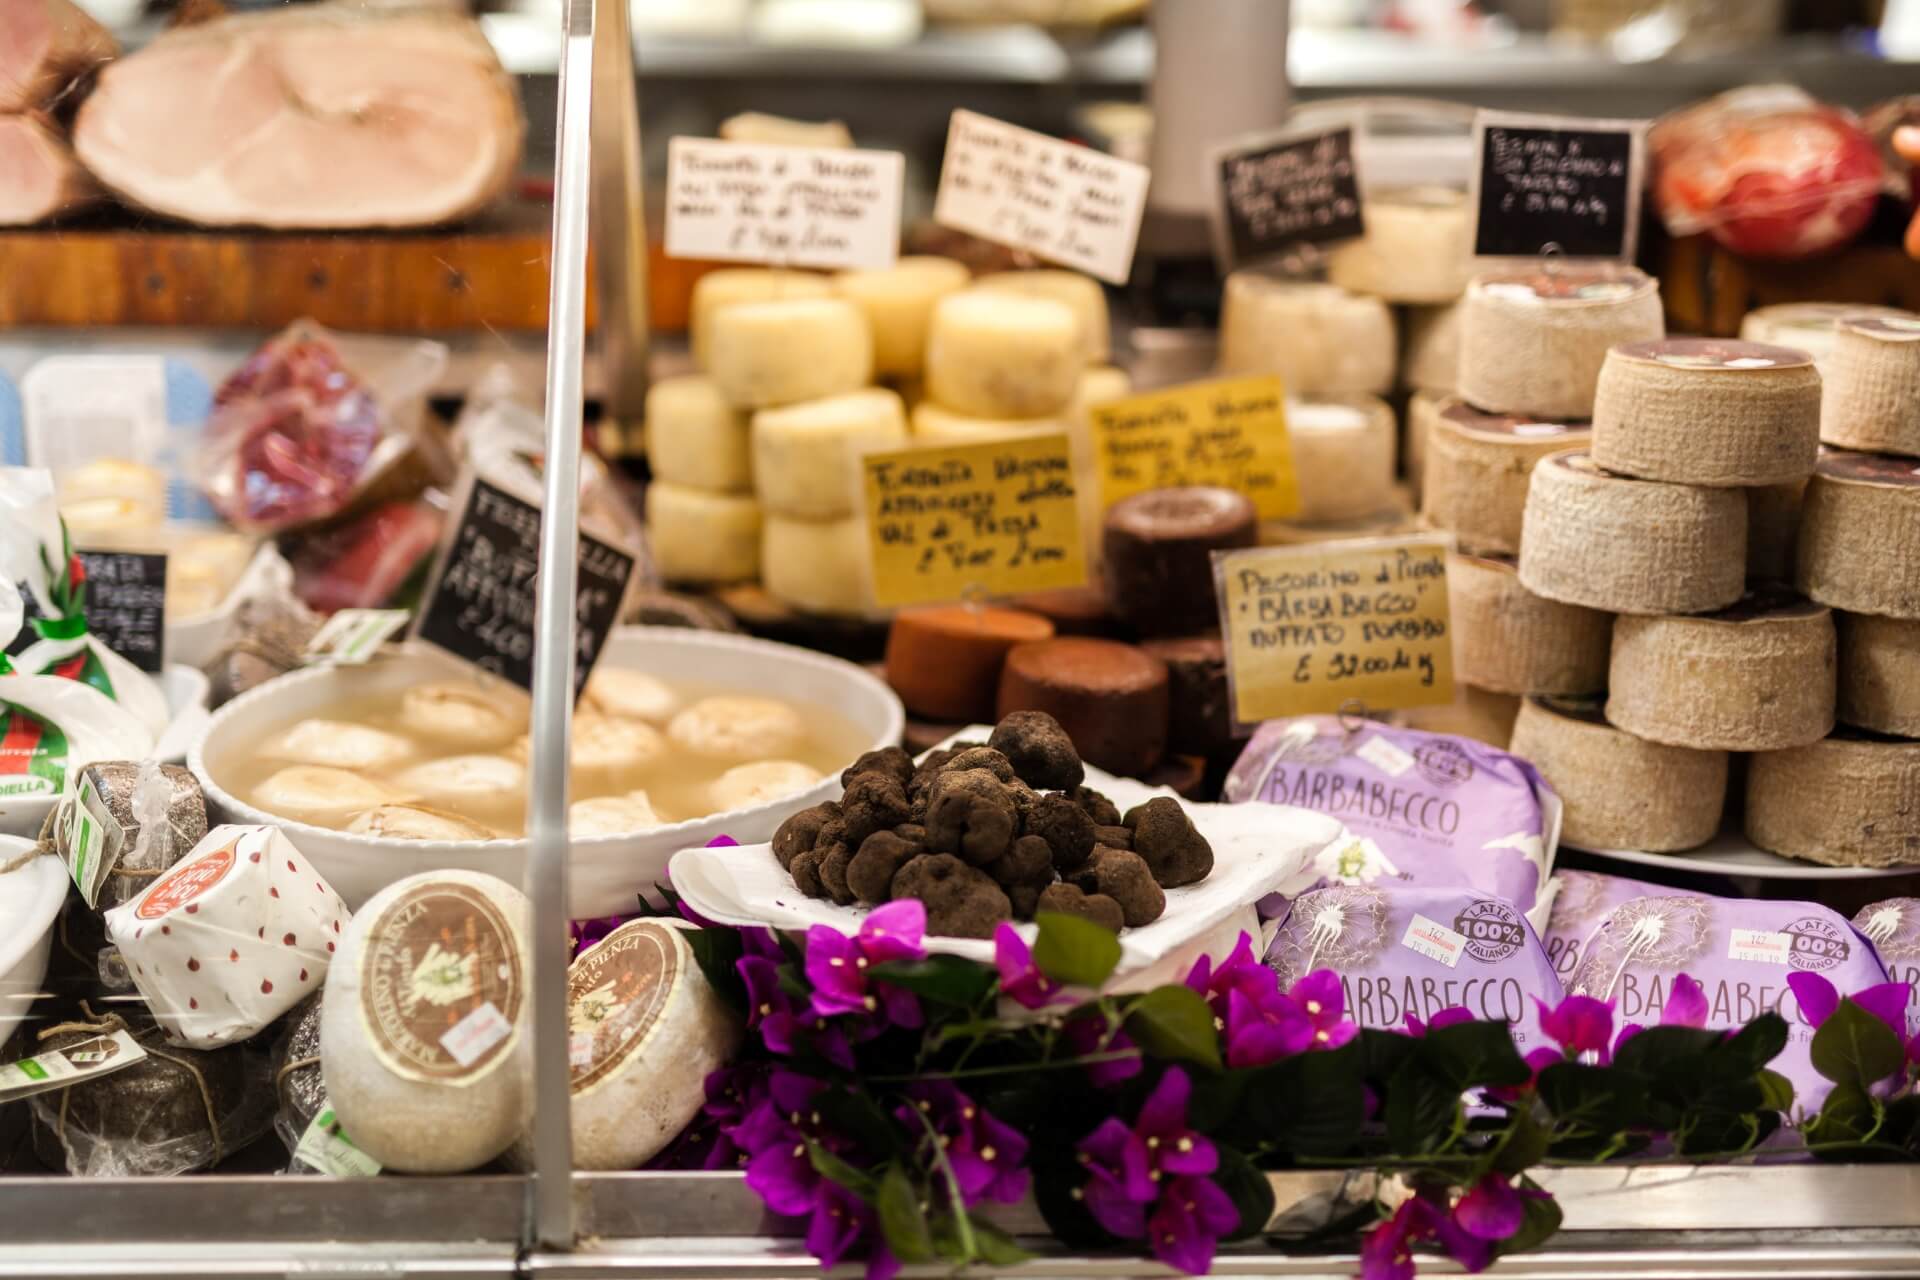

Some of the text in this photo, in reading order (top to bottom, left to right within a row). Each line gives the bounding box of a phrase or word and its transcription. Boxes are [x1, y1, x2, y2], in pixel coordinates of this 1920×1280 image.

[1271, 767, 1461, 835] BARBABECCO
[1470, 904, 1511, 921] LATTE
[1460, 920, 1520, 943] 100%
[1795, 921, 1838, 939] LATTE
[589, 937, 639, 971] PIENZA
[1466, 940, 1510, 959] ITALIANO
[1796, 936, 1845, 958] 00%
[1789, 952, 1833, 969] ITALIANO
[1340, 975, 1523, 1026] ARBABECCO
